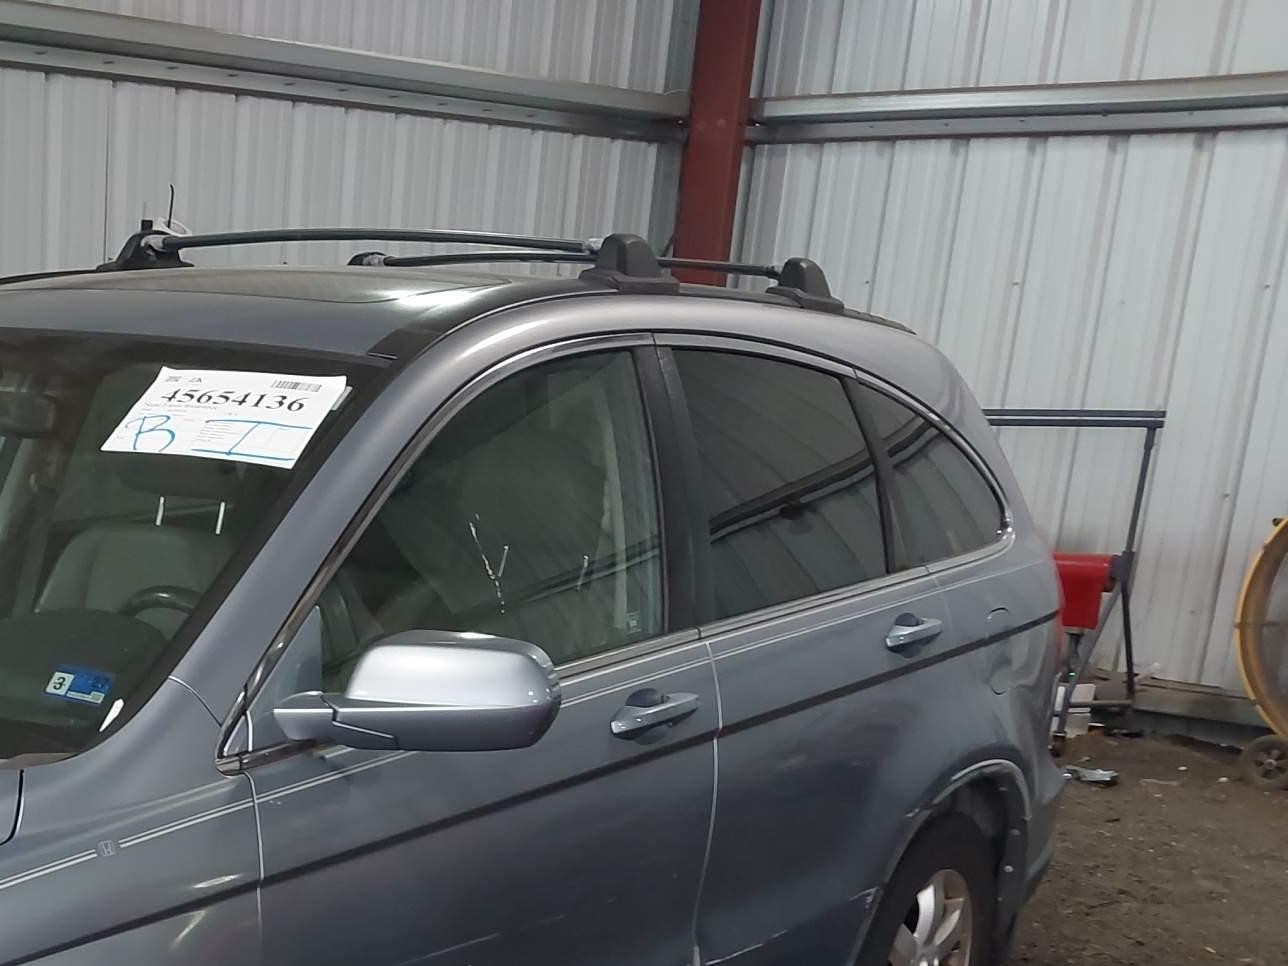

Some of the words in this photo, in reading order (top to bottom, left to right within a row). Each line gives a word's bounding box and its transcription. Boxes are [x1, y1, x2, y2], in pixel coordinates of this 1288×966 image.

[161, 388, 305, 412] 45654136
[125, 414, 176, 452] B
[53, 676, 66, 690] 3
